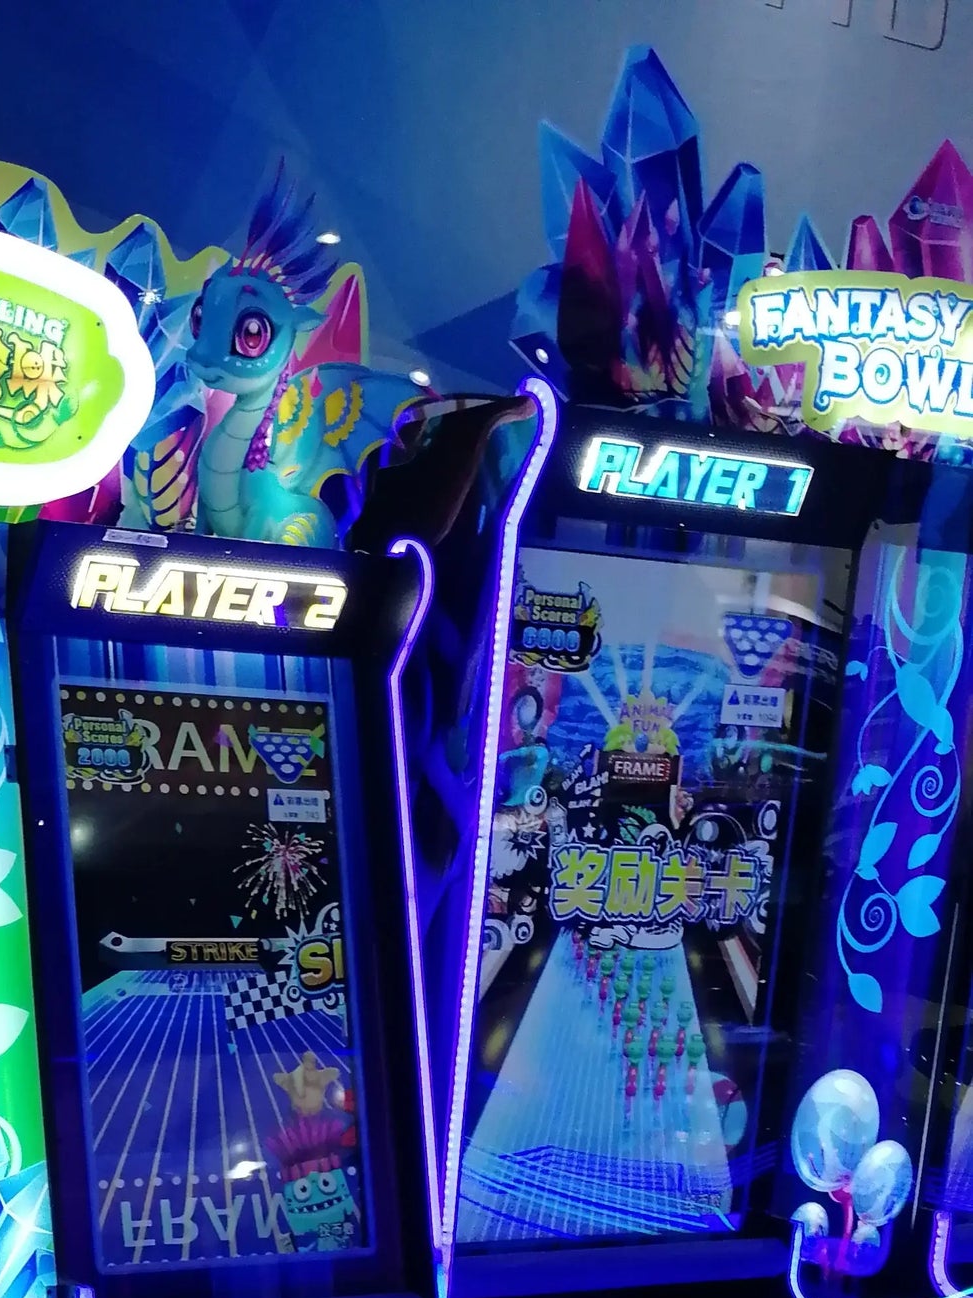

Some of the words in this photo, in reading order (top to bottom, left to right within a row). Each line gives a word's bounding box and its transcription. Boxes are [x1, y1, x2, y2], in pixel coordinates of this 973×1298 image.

[752, 287, 973, 348] FANTASY
[588, 441, 769, 509] PLAYER
[786, 468, 811, 515] 1
[78, 561, 289, 625] PLAYER
[303, 584, 347, 629] 2
[525, 588, 584, 609] Personal
[531, 606, 577, 623] Scores
[73, 718, 127, 733] Personal
[632, 720, 661, 733] FUN
[82, 731, 125, 745] Scores
[613, 760, 666, 777] FRAME
[552, 847, 757, 920] 奖励关卡
[170, 942, 259, 961] STRIKE
